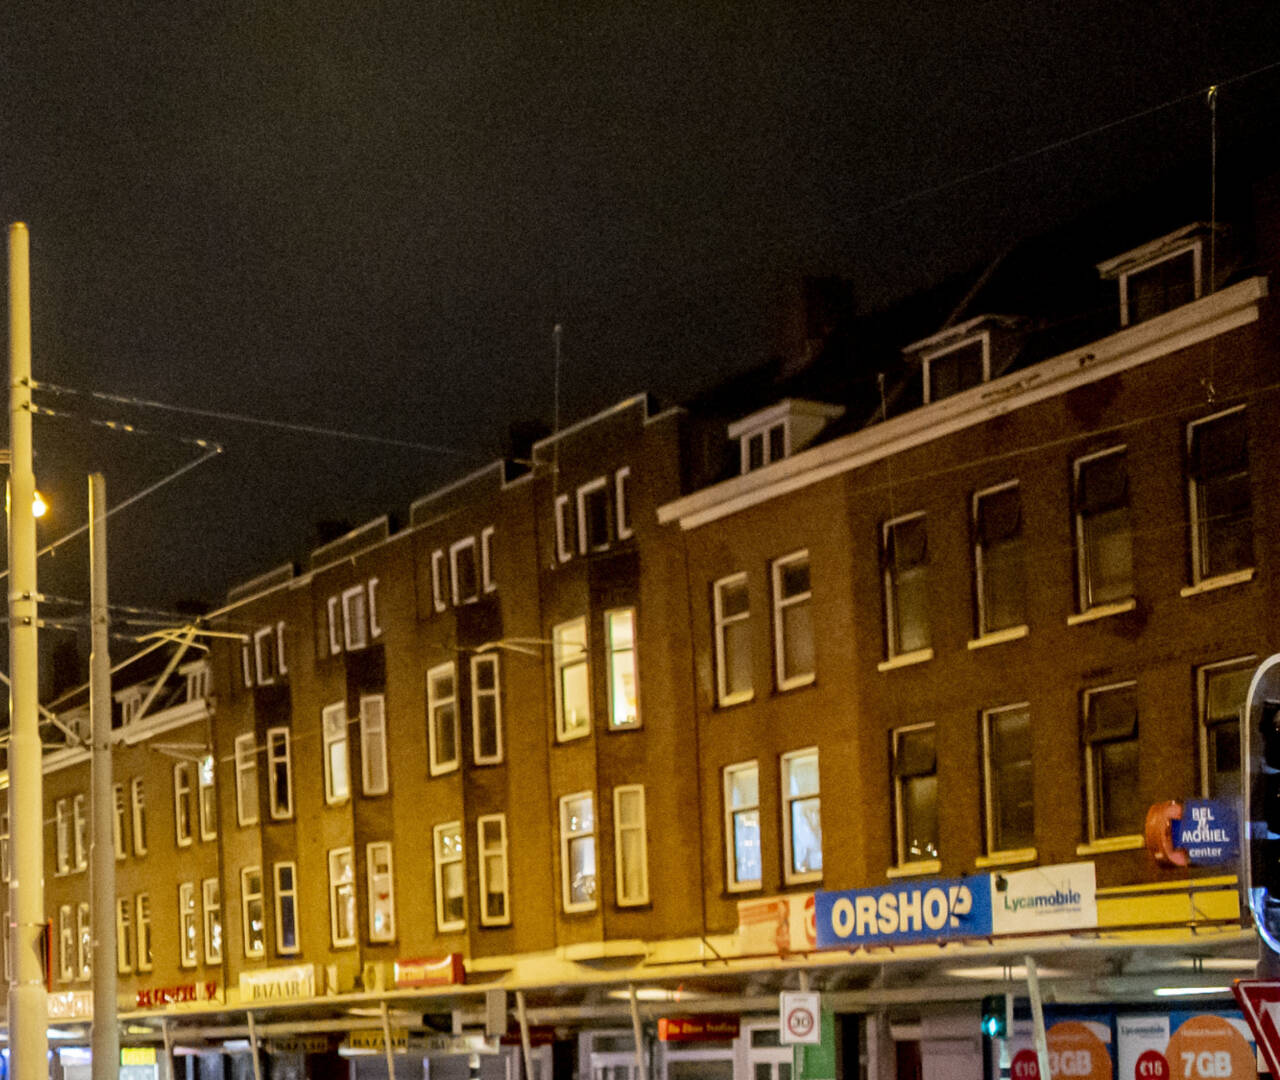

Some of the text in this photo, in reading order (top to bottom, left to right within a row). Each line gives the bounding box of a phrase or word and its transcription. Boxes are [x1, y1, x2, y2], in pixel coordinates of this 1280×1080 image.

[1191, 807, 1215, 820] BEL
[1182, 829, 1230, 843] MOBIEL
[1189, 847, 1223, 858] center
[1003, 889, 1082, 912] Lycamobile
[831, 885, 973, 938] ORSHOP
[1181, 1051, 1233, 1078] 7GB
